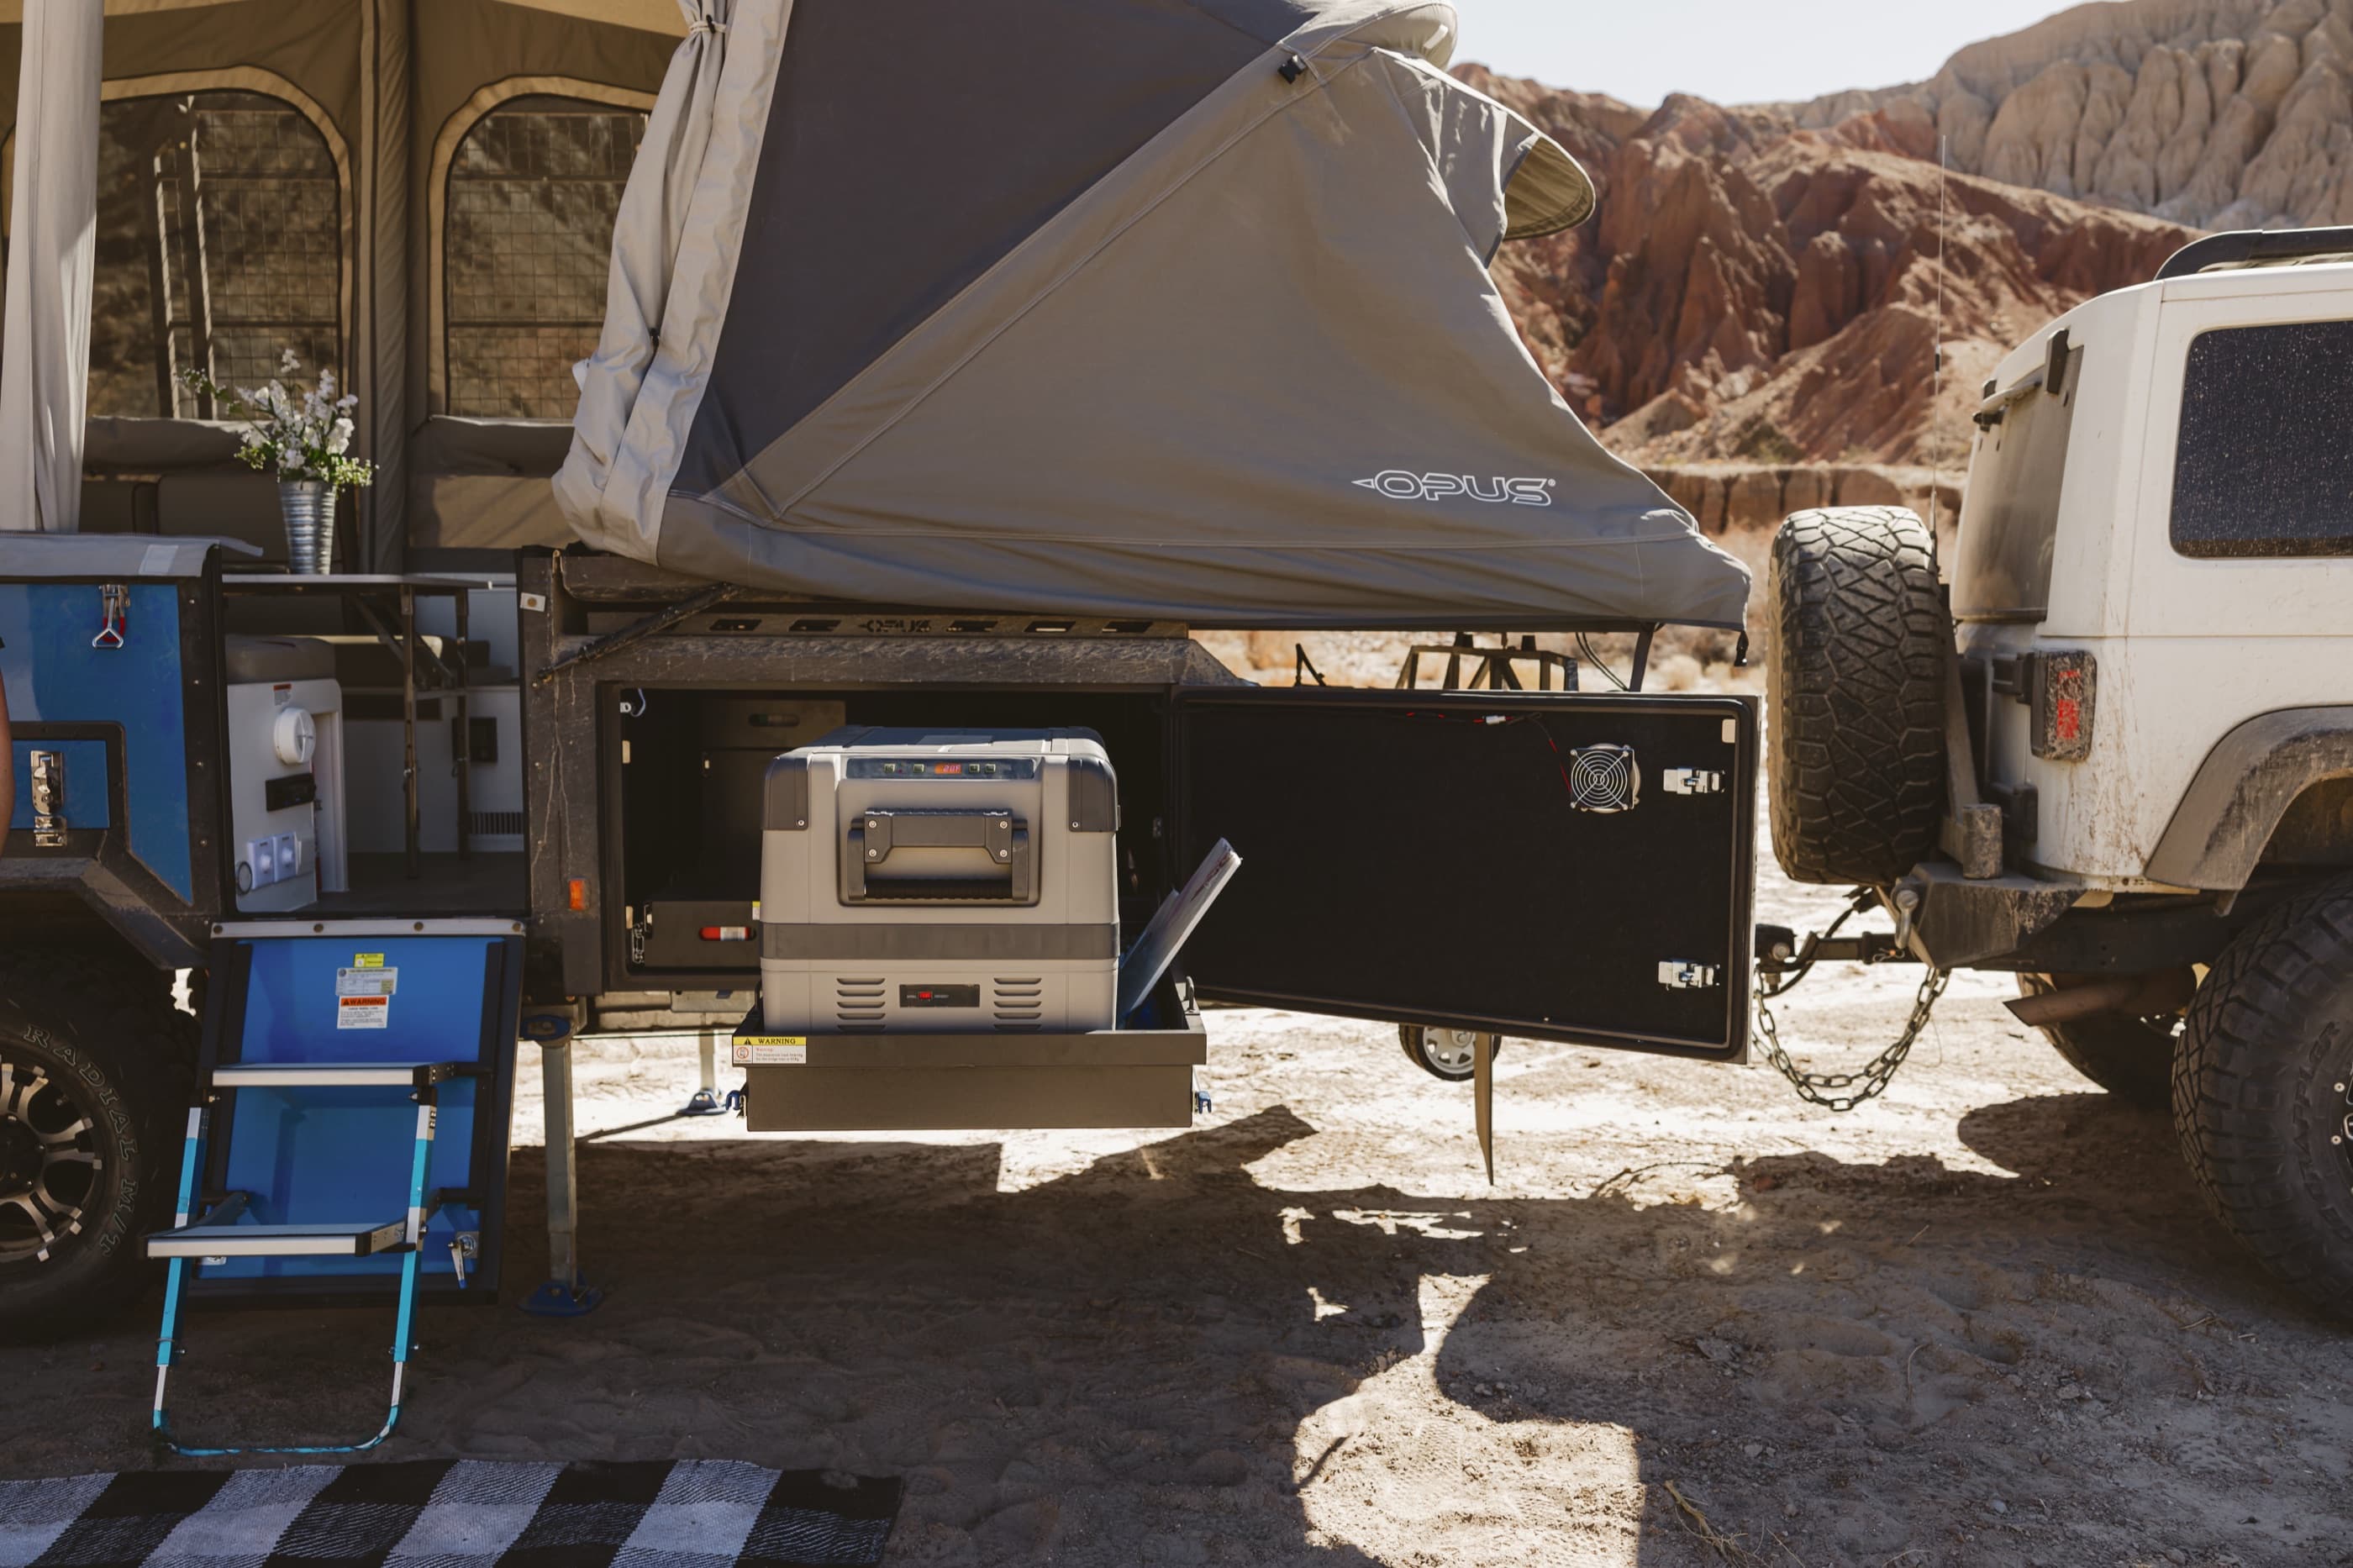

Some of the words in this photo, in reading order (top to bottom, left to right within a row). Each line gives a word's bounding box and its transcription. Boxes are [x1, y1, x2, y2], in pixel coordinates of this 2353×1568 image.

[1374, 469, 1552, 507] OPUS
[350, 997, 387, 1006] WARNING
[758, 1037, 797, 1045] WARNING
[24, 1023, 139, 1161] RADIAL
